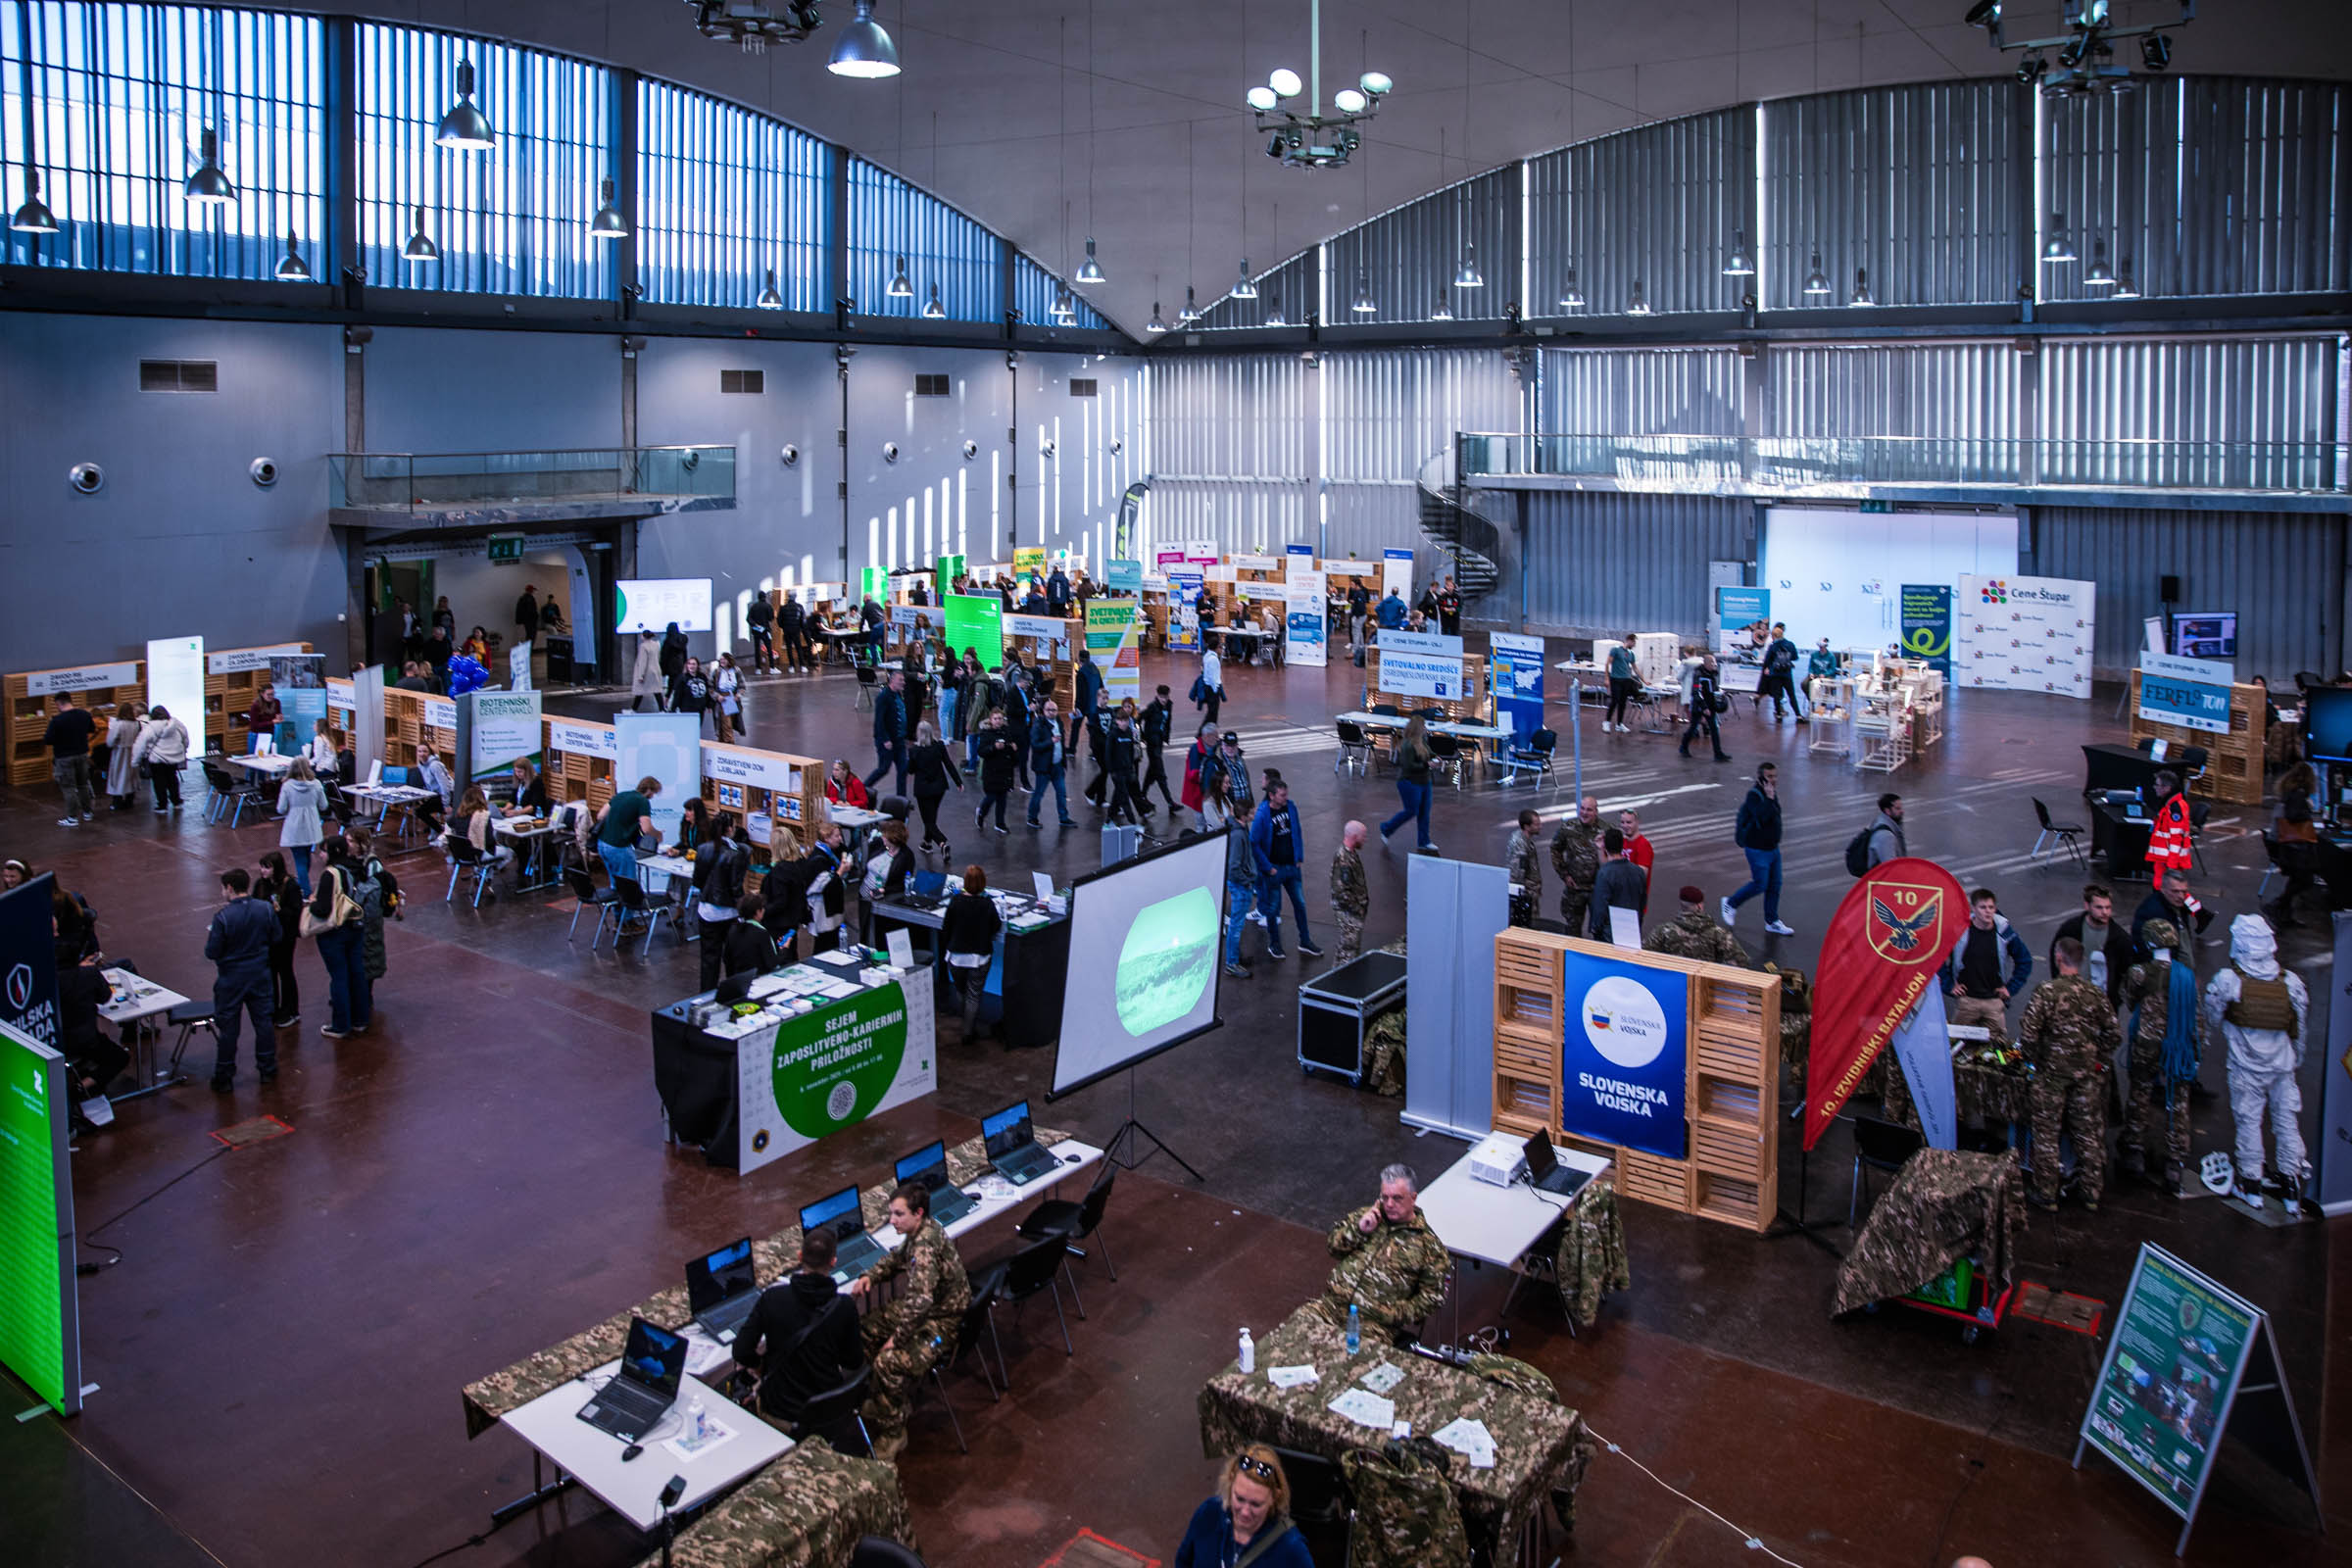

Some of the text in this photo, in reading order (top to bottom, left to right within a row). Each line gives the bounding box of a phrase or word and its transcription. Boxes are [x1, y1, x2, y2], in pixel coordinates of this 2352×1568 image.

[2011, 588, 2070, 602] Cene Štupar
[1383, 659, 1459, 674] SVETOVALNO SREDIŠČE
[691, 681, 706, 698] 99
[479, 697, 531, 708] BIOTEHNIŠKI
[478, 706, 534, 716] CENTER NAKLO
[716, 757, 765, 772] ZDRAVSTVENI DOM
[716, 764, 747, 777] LJUBLJANA
[1893, 890, 1918, 906] 10
[10, 1000, 55, 1030] ILSKA
[825, 1010, 858, 1033] SEJEM
[1620, 1014, 1662, 1030] SLOVENSKA
[776, 1008, 903, 1070] ZAPOSLITVENO-KARIERNIH
[1620, 1025, 1647, 1037] VOJSKA
[1819, 1096, 1839, 1118] 10.
[1834, 1031, 1884, 1099] IZVIDNIŠKI
[1877, 971, 1927, 1035] BATALJON
[810, 1037, 872, 1072] PRILOŽNOSTI
[1579, 1071, 1669, 1105] SLOVENSKA
[1593, 1090, 1653, 1118] VOJSKA
